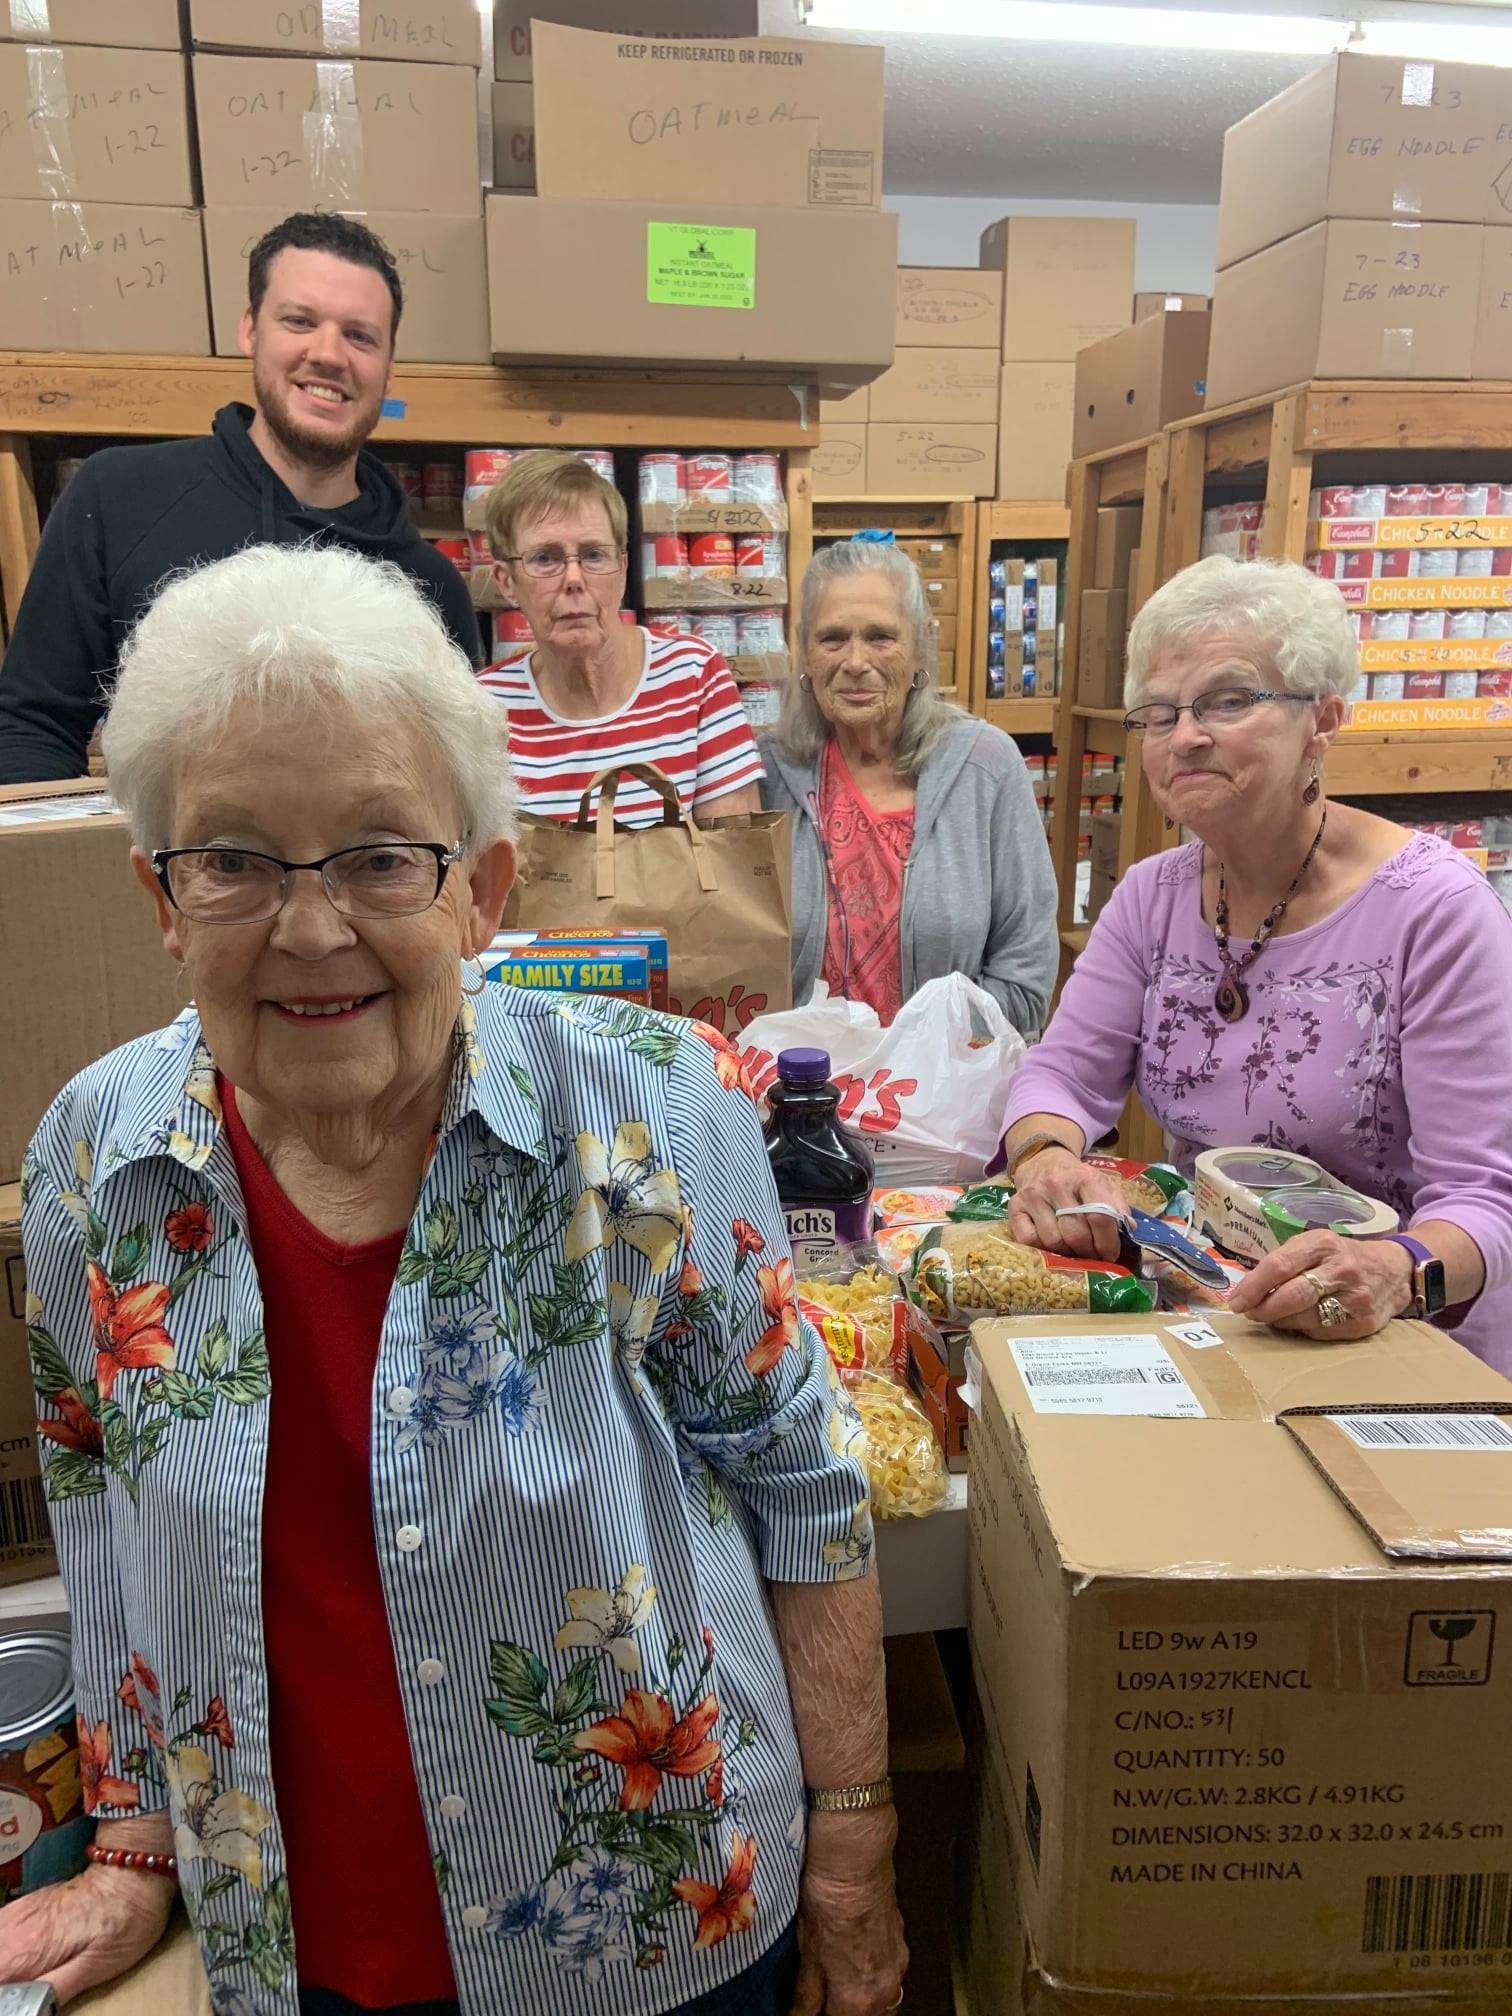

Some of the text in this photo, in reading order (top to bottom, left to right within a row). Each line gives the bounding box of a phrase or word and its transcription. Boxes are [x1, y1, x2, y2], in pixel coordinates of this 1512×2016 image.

[617, 44, 803, 65] KEEP REFRIGERATED OR FROZEN
[228, 90, 286, 117] OAT
[105, 124, 169, 165] 1-22
[1346, 136, 1485, 156] EGG NOODLE
[658, 267, 682, 275] MAPLE
[691, 270, 718, 279] BROWN
[1343, 282, 1450, 302] EGG NOODLE
[1380, 526, 1443, 542] CHICKEN
[1449, 525, 1509, 541] NOODLE
[1414, 519, 1490, 543] 5-22
[1372, 586, 1436, 601] CHICKEN
[1441, 584, 1500, 600] NOODLE
[1365, 647, 1428, 663] CHICKEN
[1432, 646, 1489, 662] NOODLE
[1357, 708, 1418, 724] CHICKEN
[1424, 706, 1482, 721] NOODLE
[501, 964, 624, 988] FAMILY SIZE
[1230, 1220, 1269, 1254] PREMIUM
[804, 1247, 839, 1256] Concord
[1183, 1328, 1217, 1342] 01
[1118, 1631, 1258, 1650] LED 9w A19
[1116, 1669, 1313, 1691] L09A1927KENCL
[1417, 1668, 1481, 1681] FRAGILE
[1113, 1747, 1286, 1774] QUANTITY: 50
[1112, 1787, 1229, 1809] N.W/G.W:
[1235, 1785, 1301, 1806] 2.8KG
[1324, 1784, 1405, 1804] 4.91KG
[1111, 1821, 1505, 1847] DIMENSIONS: 32.0 x 32.0 x 24.5 cm
[1109, 1862, 1304, 1884] MADE IN CHINA
